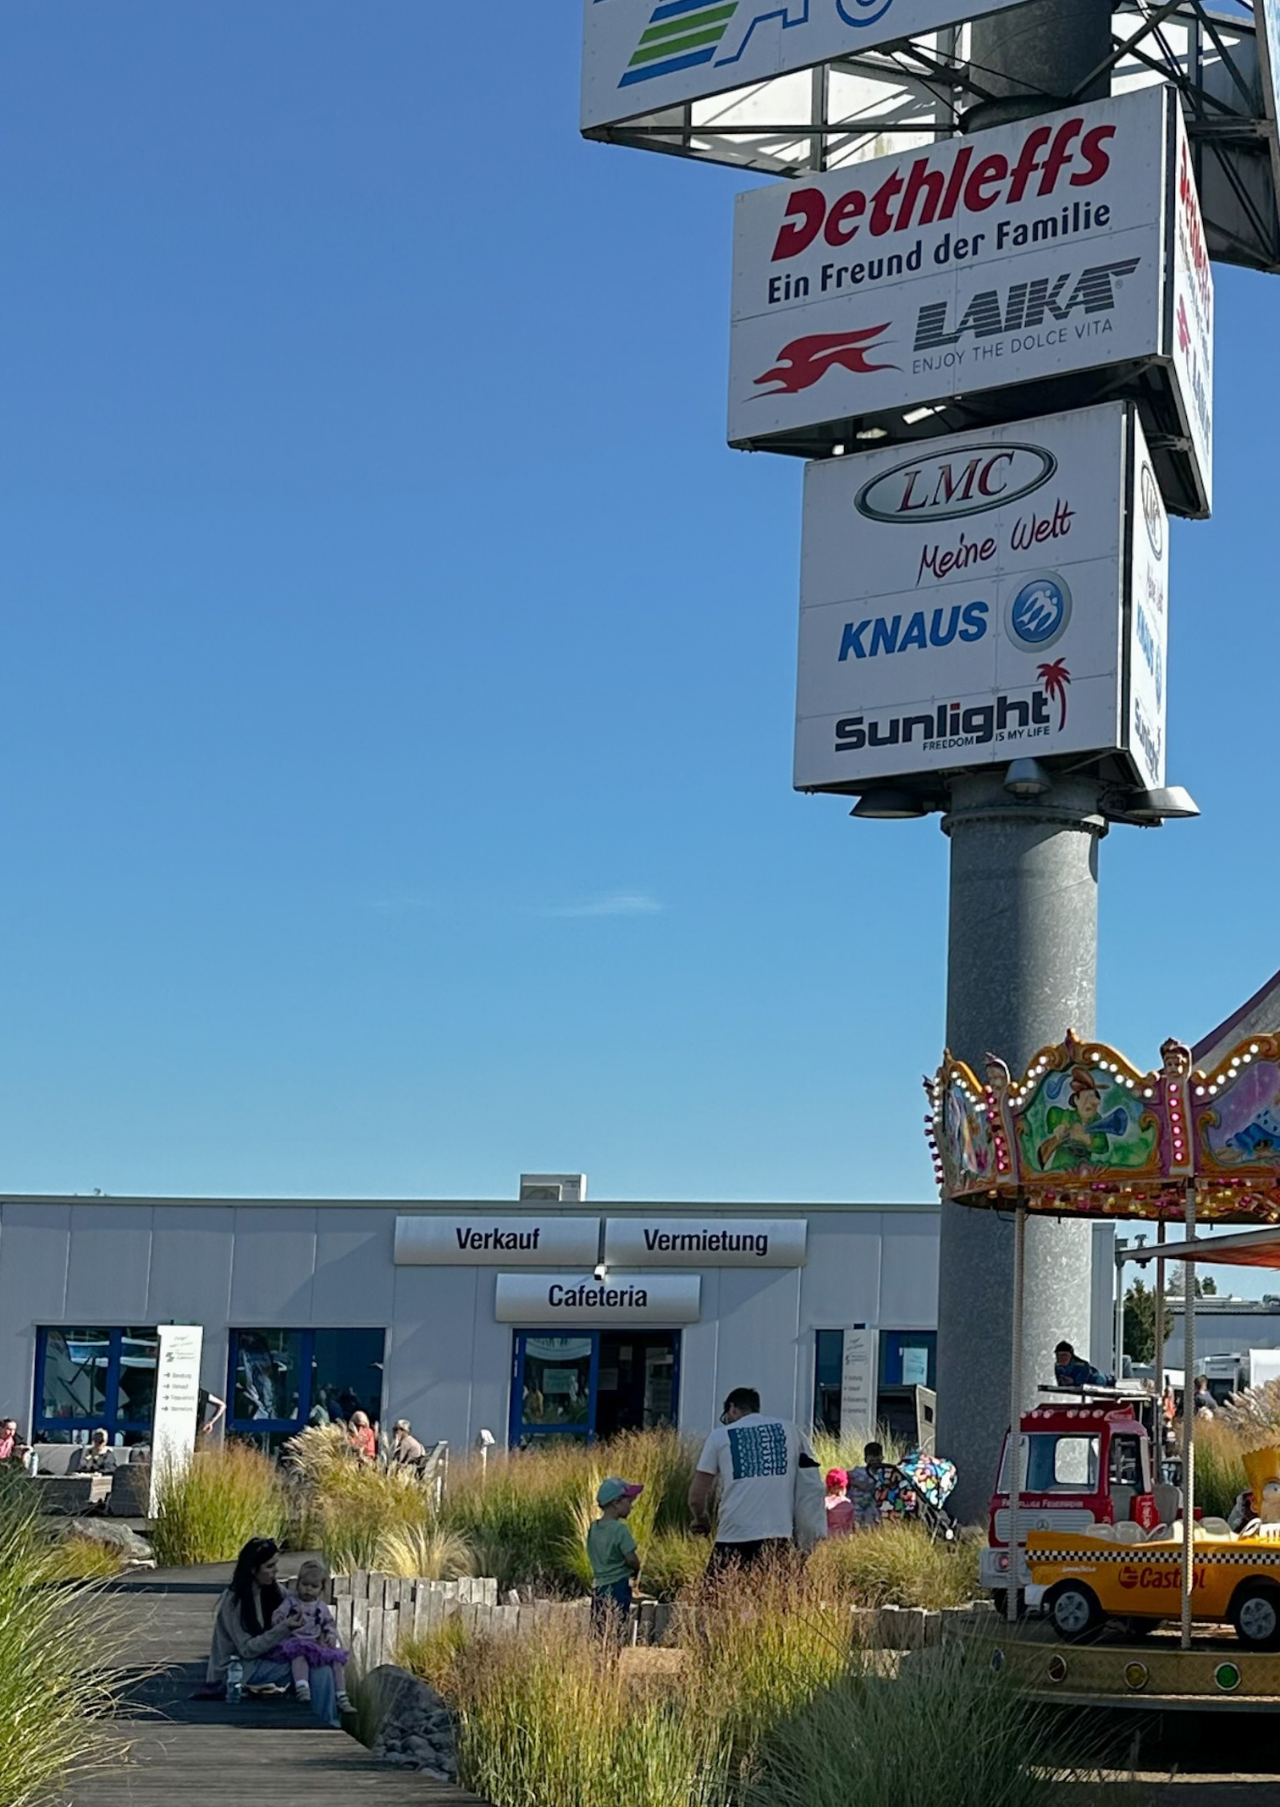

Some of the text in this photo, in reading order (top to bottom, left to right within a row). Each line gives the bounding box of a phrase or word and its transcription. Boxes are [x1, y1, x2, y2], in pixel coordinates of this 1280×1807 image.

[771, 118, 1116, 262] Dethleffs
[768, 201, 1110, 304] Ein Freund der Familie
[913, 257, 1141, 352] LAIKA
[912, 318, 1113, 374] ENJOY THE DOLCE VITA
[895, 450, 1015, 513] LMC
[915, 497, 1077, 586] Meine Welt
[837, 601, 989, 662] KNAUS
[835, 690, 1050, 752] Sunlight
[922, 725, 1050, 751] FREEDOM IS MY LIFE
[455, 1228, 540, 1250] Verkauf
[643, 1229, 768, 1256] Vermietung
[548, 1284, 647, 1308] Cafeteria
[1140, 1566, 1205, 1590] Castl
